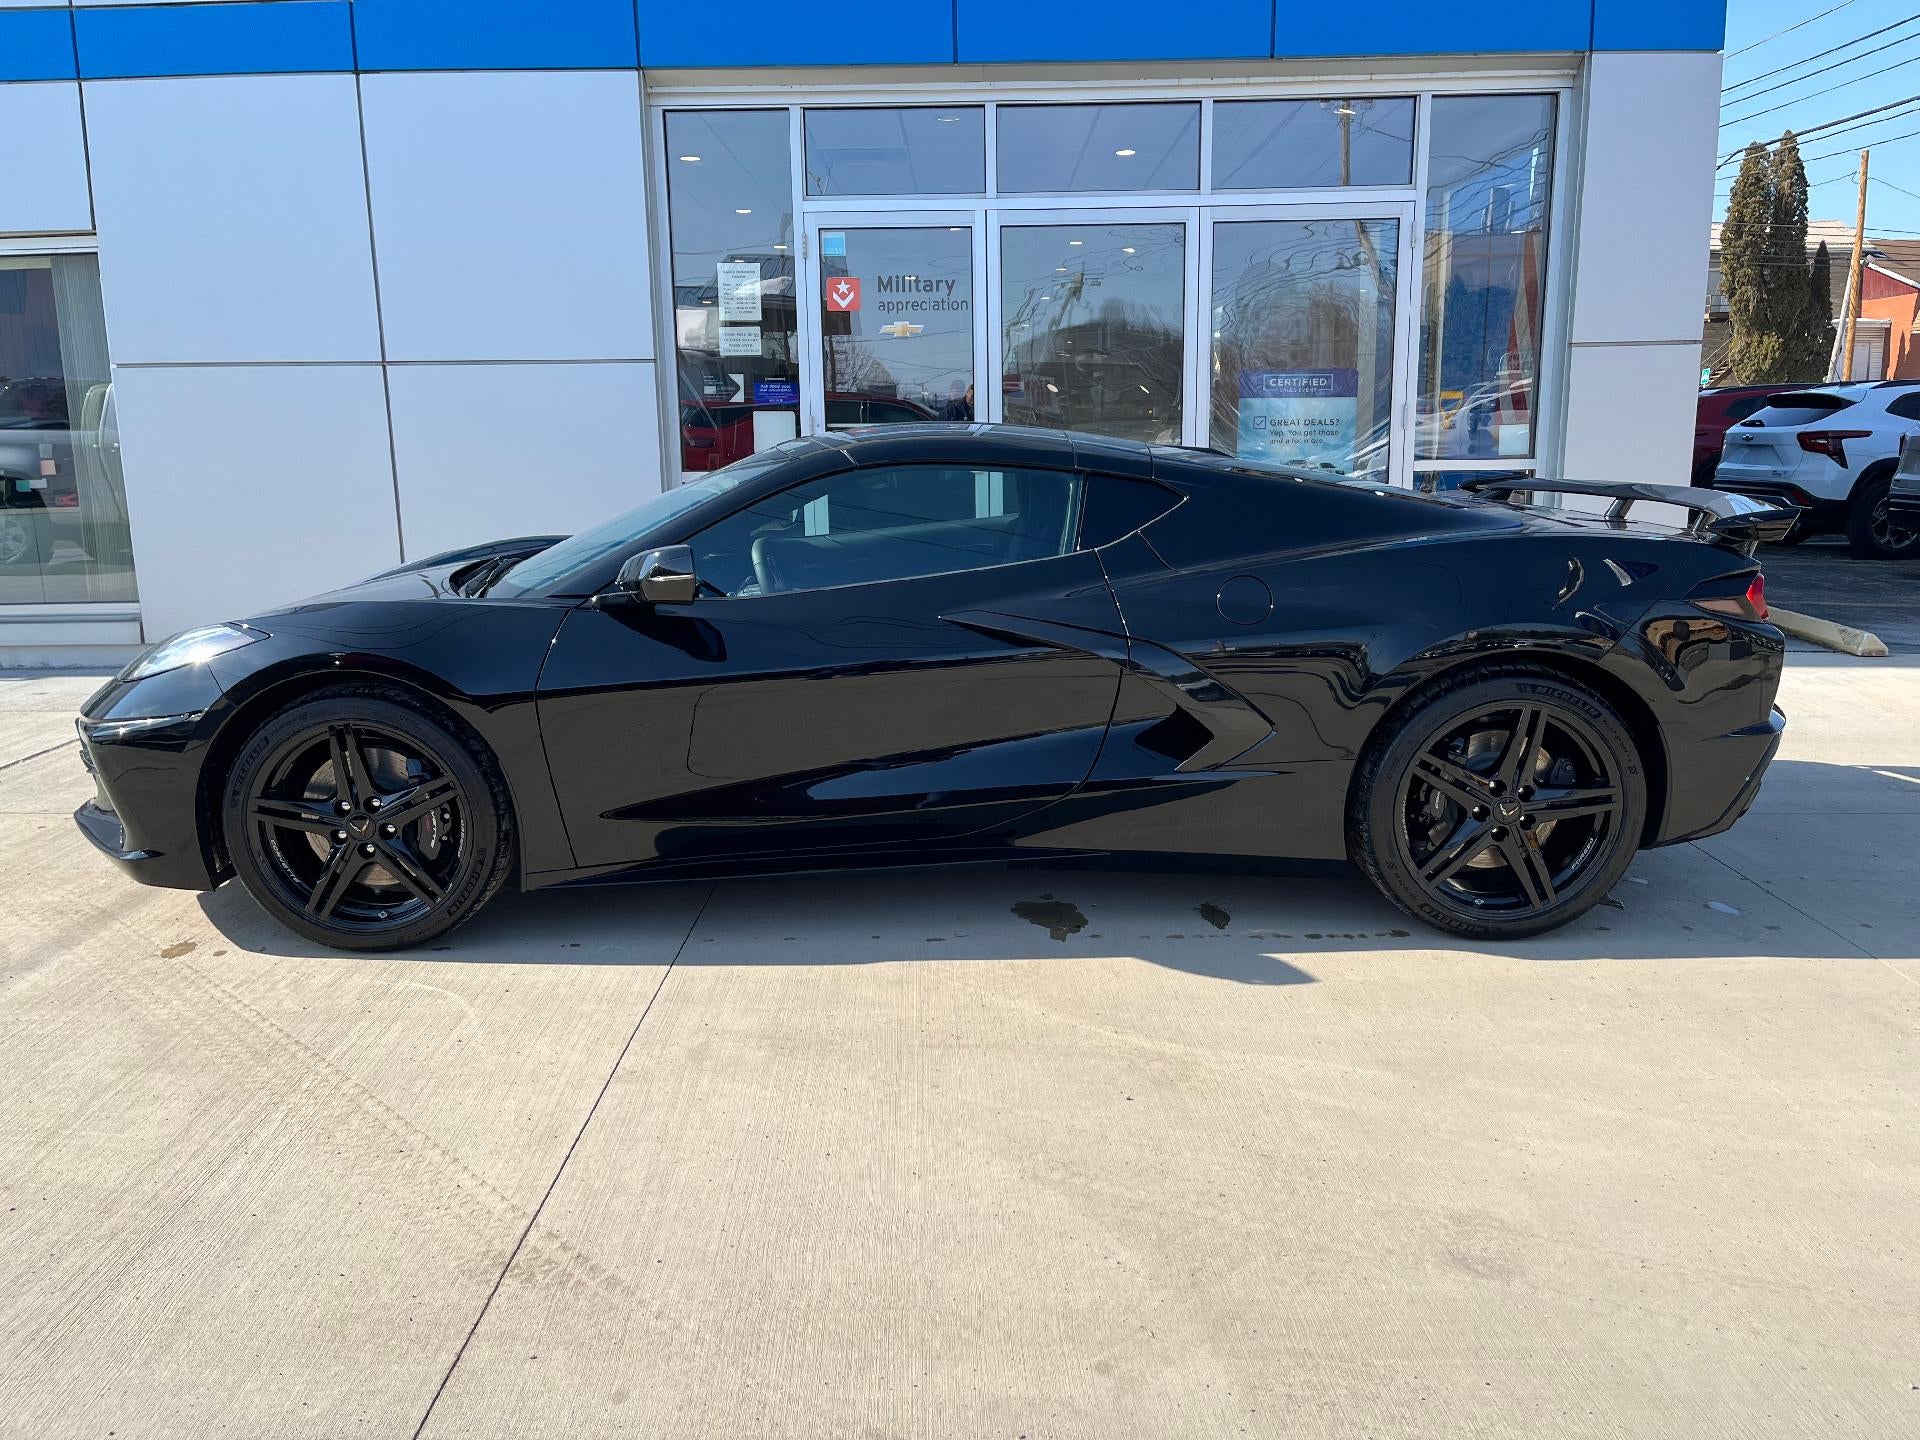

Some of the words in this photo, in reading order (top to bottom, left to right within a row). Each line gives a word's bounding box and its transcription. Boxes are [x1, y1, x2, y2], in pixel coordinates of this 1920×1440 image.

[877, 274, 956, 297] Military
[878, 297, 969, 314] appreciation
[1269, 378, 1328, 387] CERTIFIED
[1269, 418, 1300, 427] GREAT
[1303, 417, 1340, 426] DEALS?
[1534, 684, 1603, 720] MICHELIN
